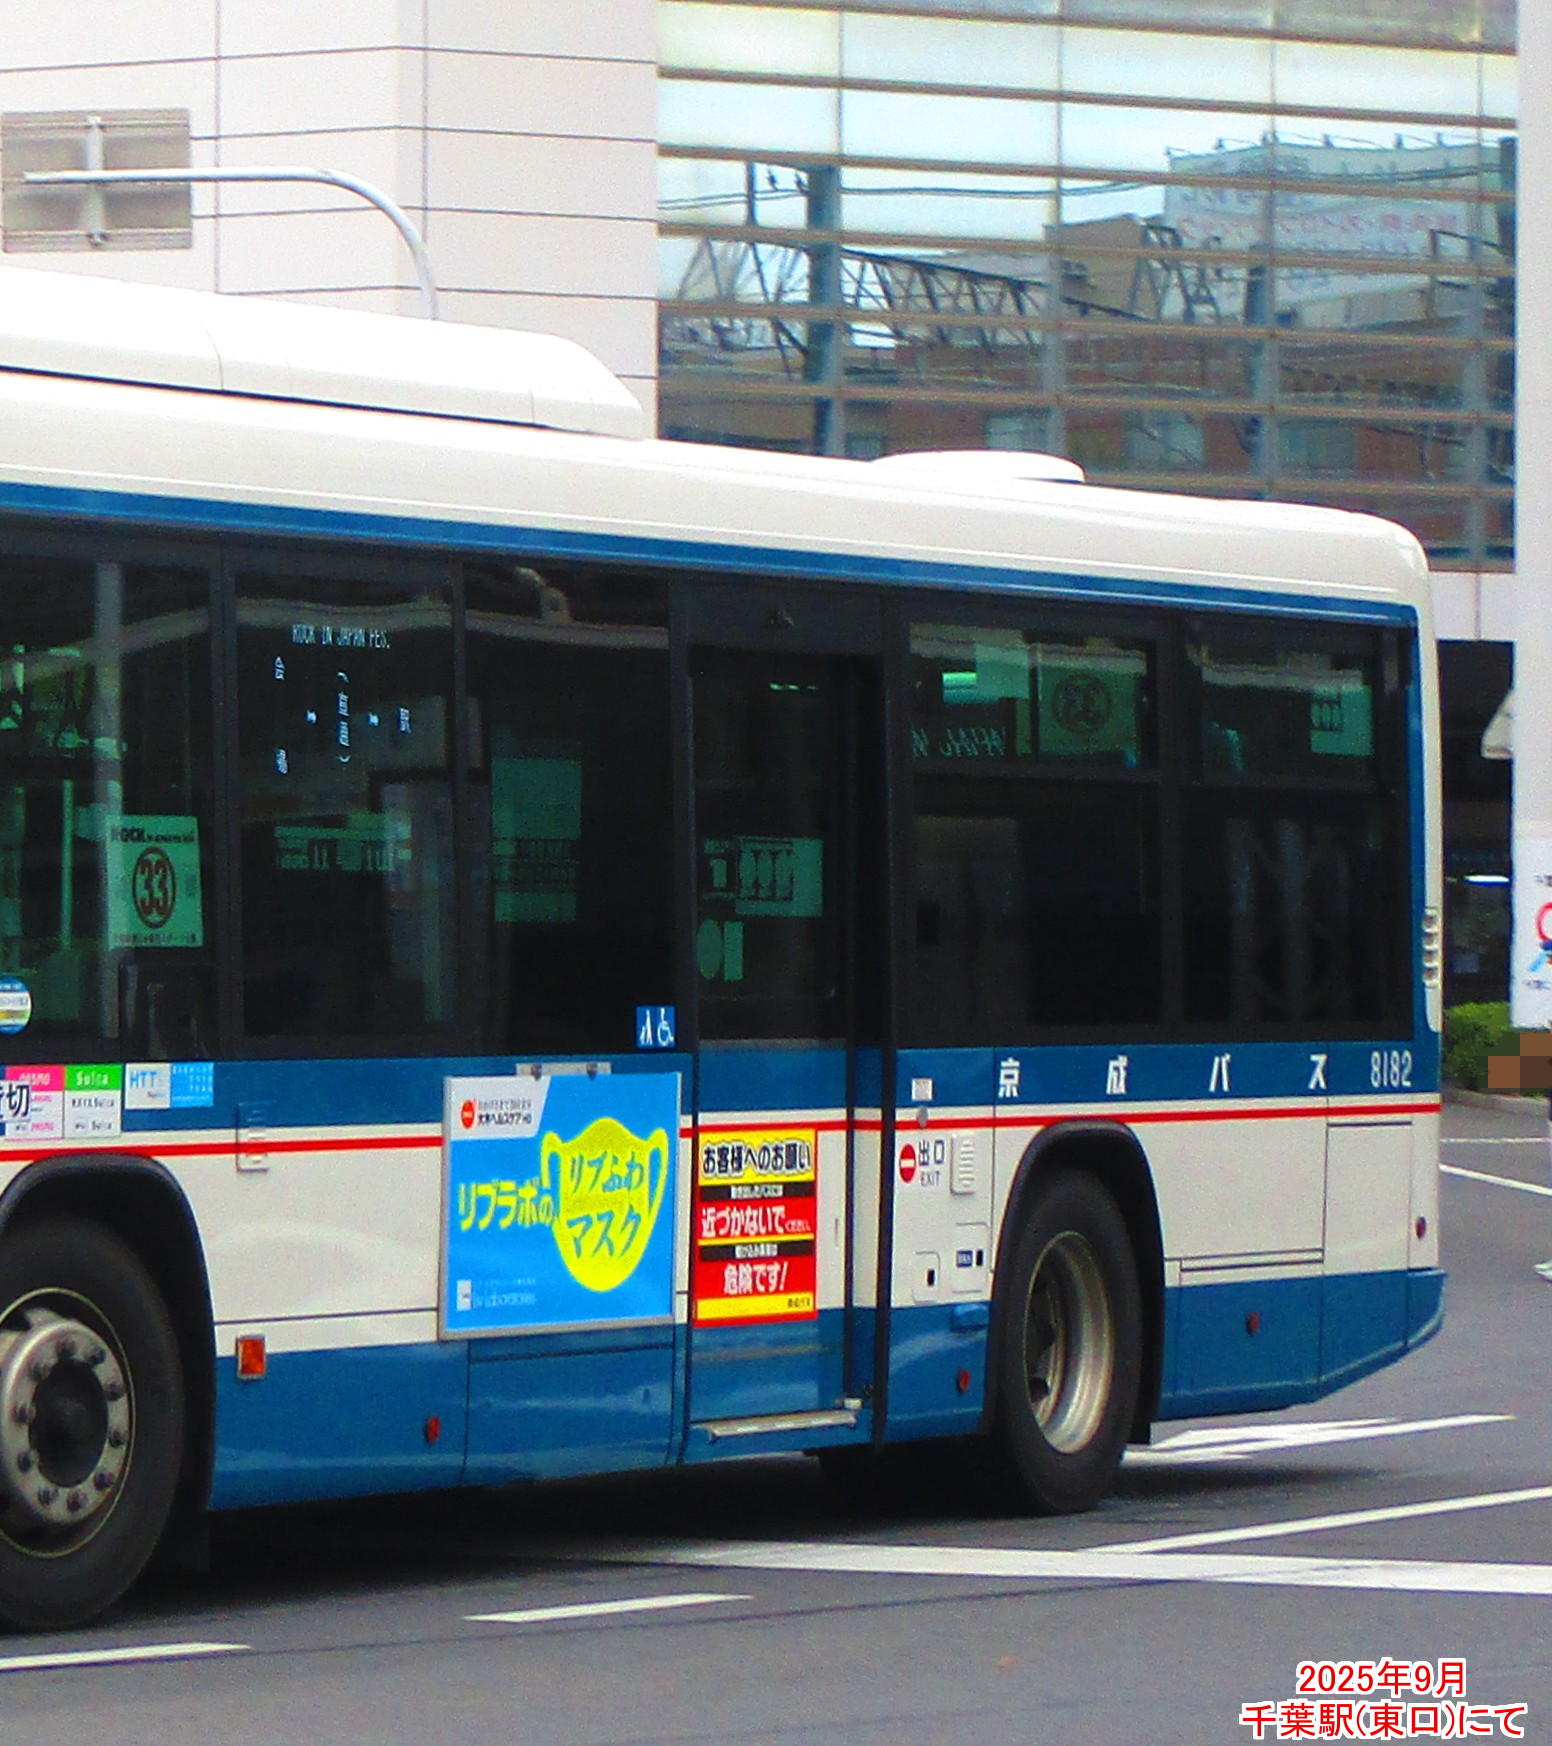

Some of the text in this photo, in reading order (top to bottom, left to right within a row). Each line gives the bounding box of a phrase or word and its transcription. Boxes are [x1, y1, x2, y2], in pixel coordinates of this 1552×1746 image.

[140, 858, 168, 916] 33
[76, 1071, 109, 1086] Suica
[998, 1053, 1327, 1098] 京成バス
[1371, 1050, 1412, 1088] 8182
[703, 1141, 811, 1175] お客様へのお願い
[919, 1139, 945, 1167] 出口
[921, 1171, 940, 1187] EXIT
[566, 1204, 642, 1259] マスク
[702, 1205, 785, 1237] 近づかないで
